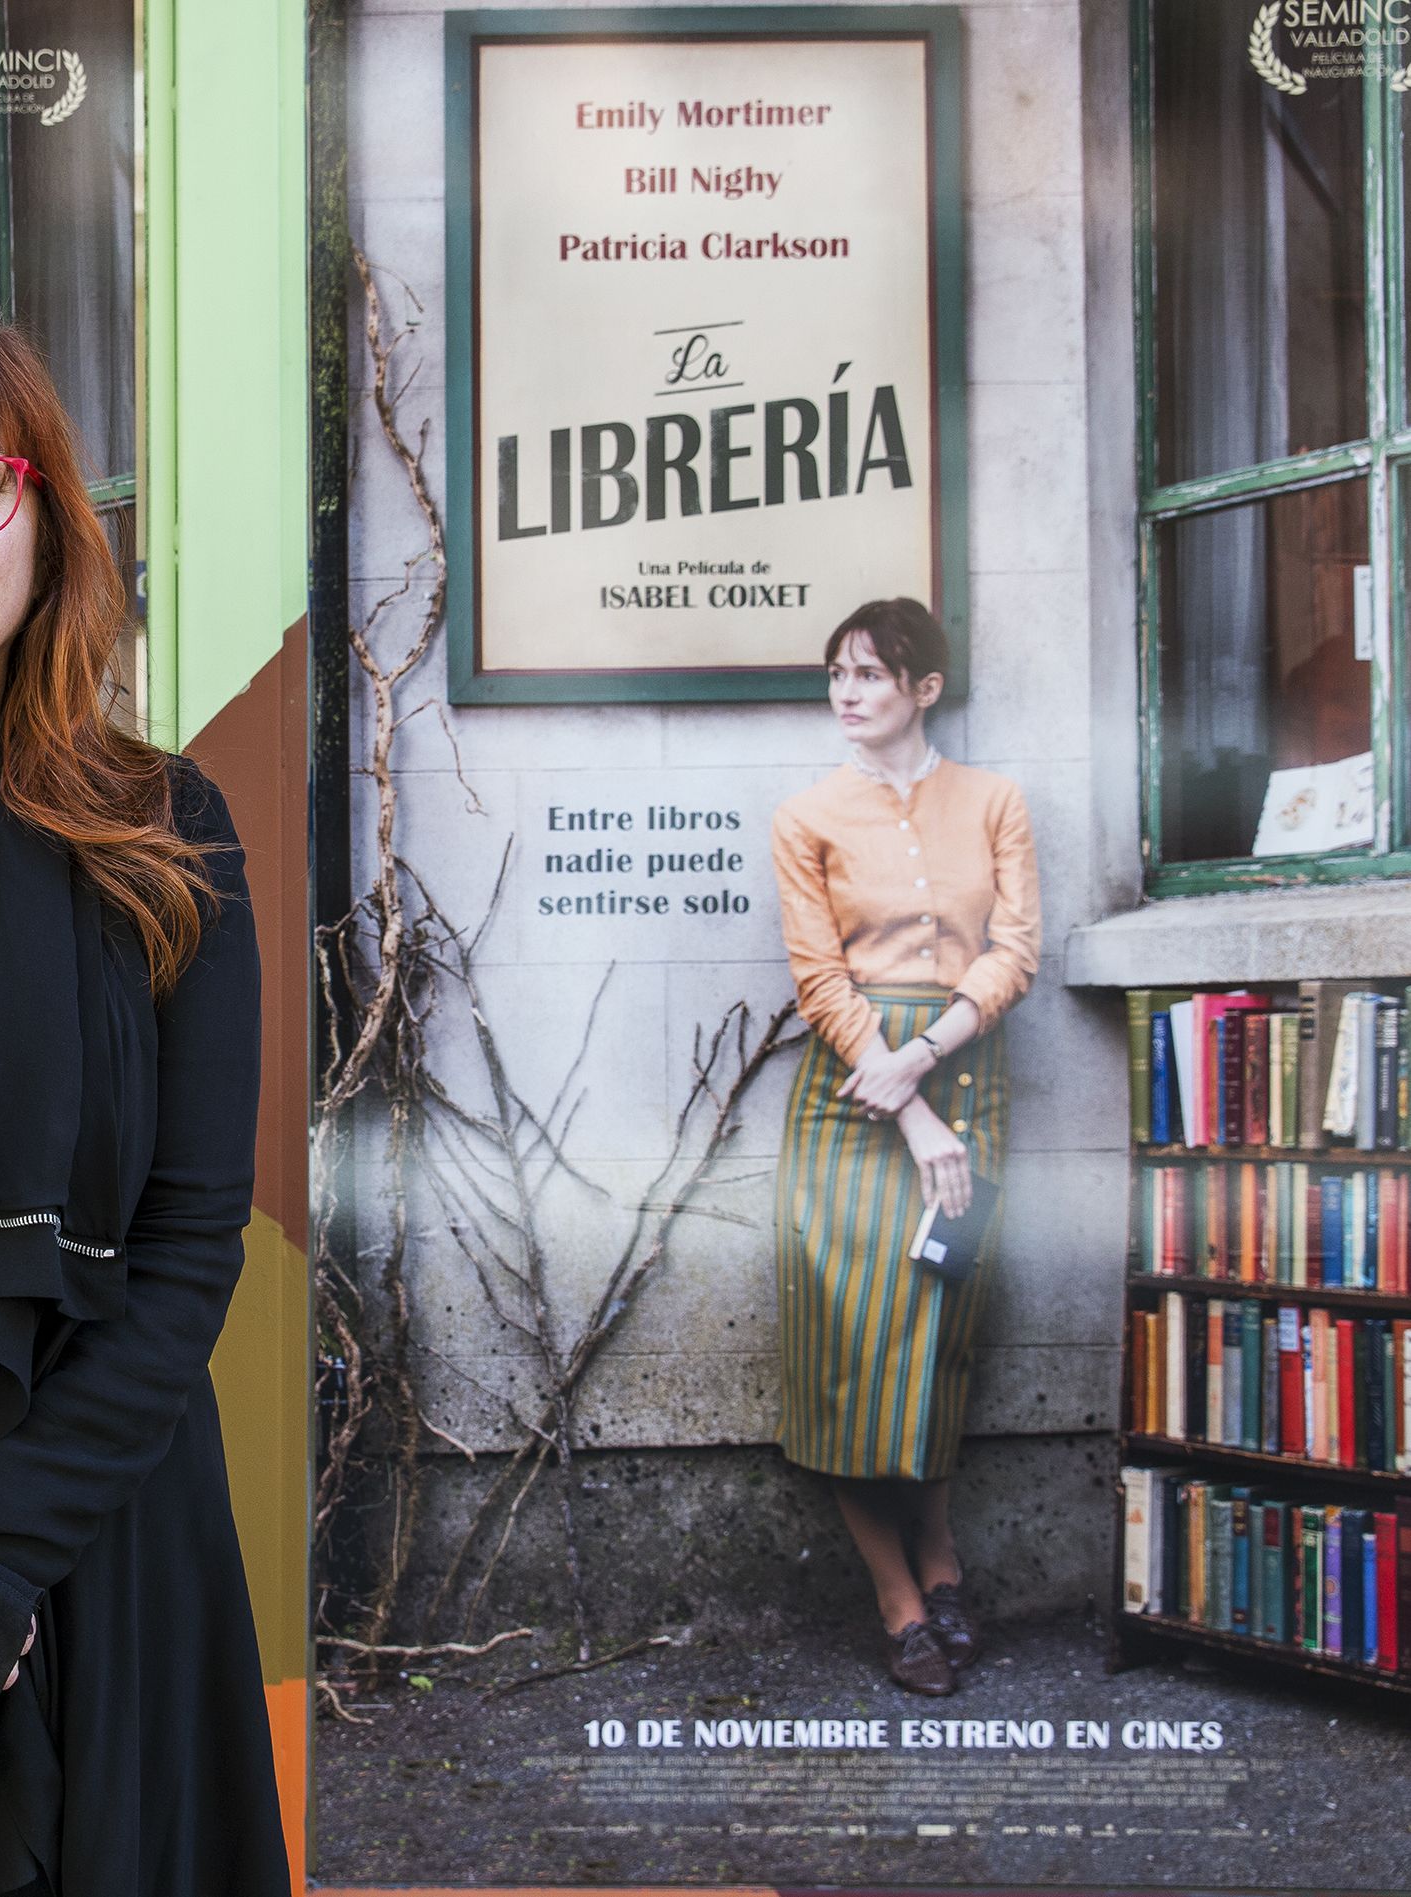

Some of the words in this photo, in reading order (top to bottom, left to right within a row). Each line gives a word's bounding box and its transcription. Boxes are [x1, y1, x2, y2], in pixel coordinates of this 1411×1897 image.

[1290, 28, 1410, 48] VALLADOLID
[575, 100, 665, 134] Emily
[676, 99, 831, 128] Mortimer
[624, 167, 678, 194] Bill
[690, 166, 783, 199] Nighy
[559, 234, 688, 261] Patricia
[701, 231, 850, 259] Clarkson
[664, 334, 729, 385] La
[498, 361, 914, 542] LIBRERÍA
[638, 560, 671, 576] Una
[677, 560, 745, 577] Película
[751, 560, 772, 576] de
[600, 586, 697, 609] ISABEL
[708, 584, 811, 608] COIXET
[548, 806, 633, 831] Entre
[648, 806, 740, 830] libros
[545, 849, 632, 873] nadie
[648, 848, 743, 878] puede
[538, 891, 670, 915] sentirse
[684, 890, 751, 915] solo
[583, 1719, 626, 1748] 10
[637, 1719, 683, 1748] DE
[694, 1719, 890, 1748] NOVIEMBRE
[900, 1719, 1055, 1749] ESTRENO
[1065, 1720, 1110, 1749] EN
[1121, 1720, 1224, 1750] CINES
